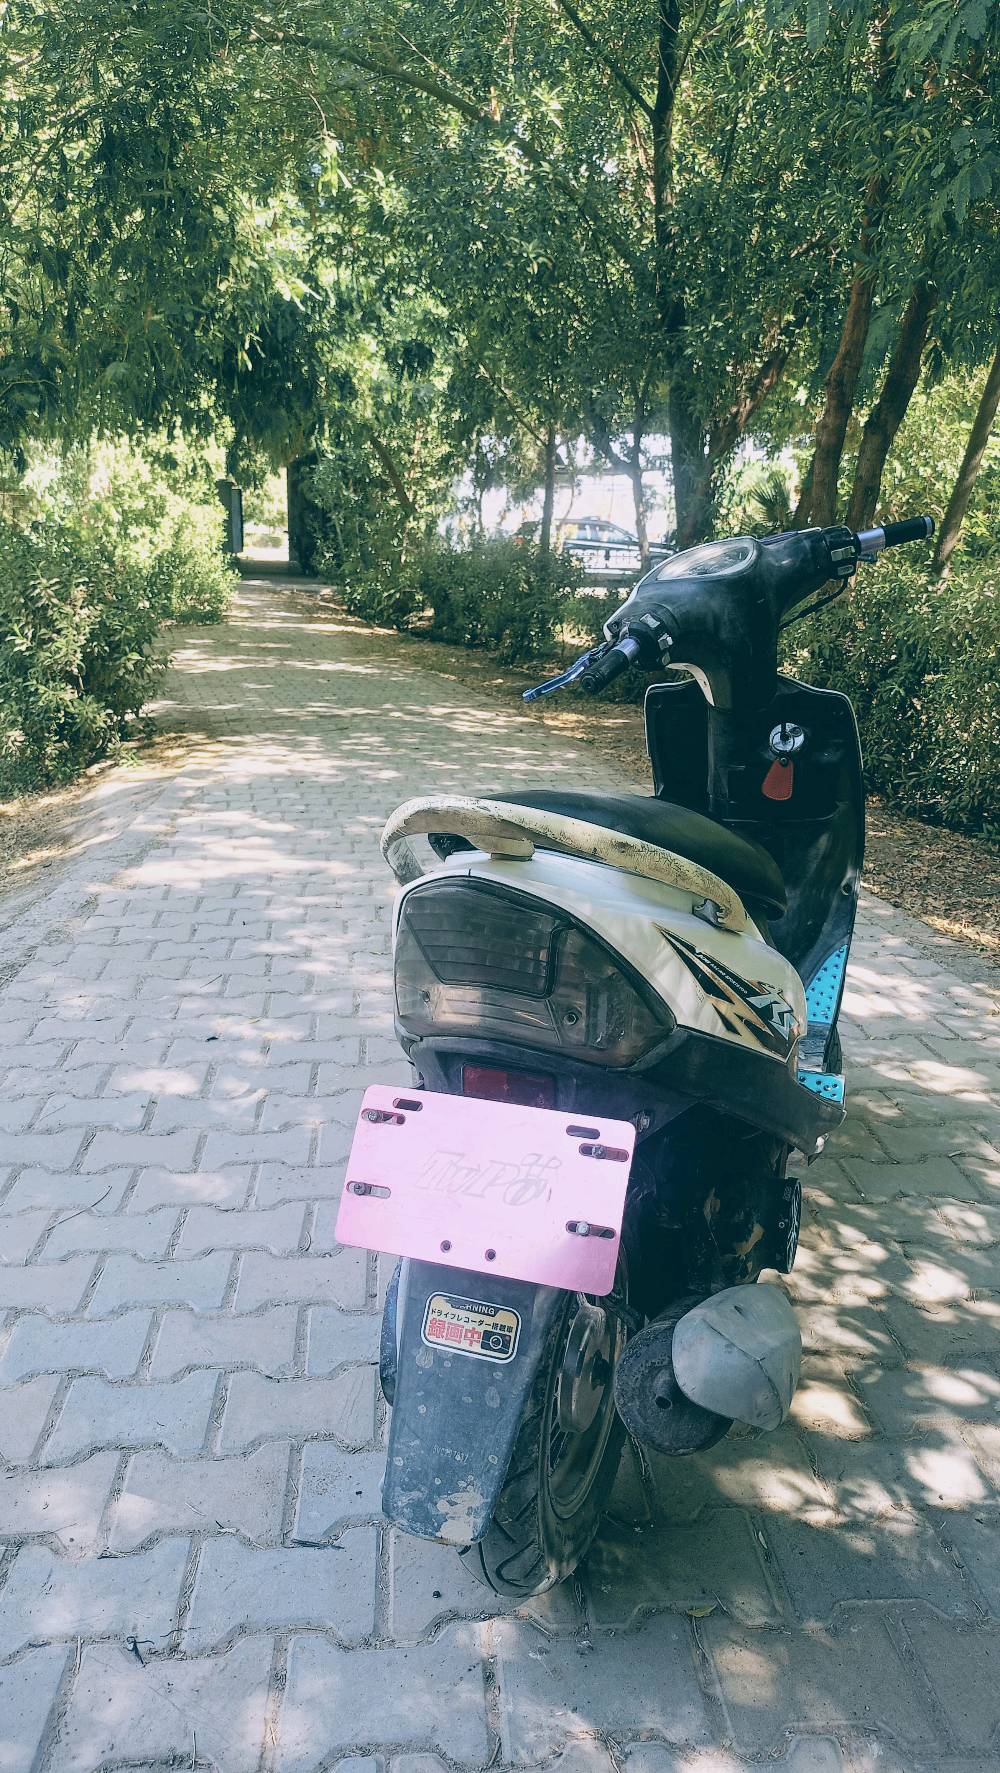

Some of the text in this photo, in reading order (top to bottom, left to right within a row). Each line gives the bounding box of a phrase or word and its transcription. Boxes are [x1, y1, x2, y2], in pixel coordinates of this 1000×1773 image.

[456, 1302, 496, 1315] RNING
[427, 1317, 482, 1347] 録画中
